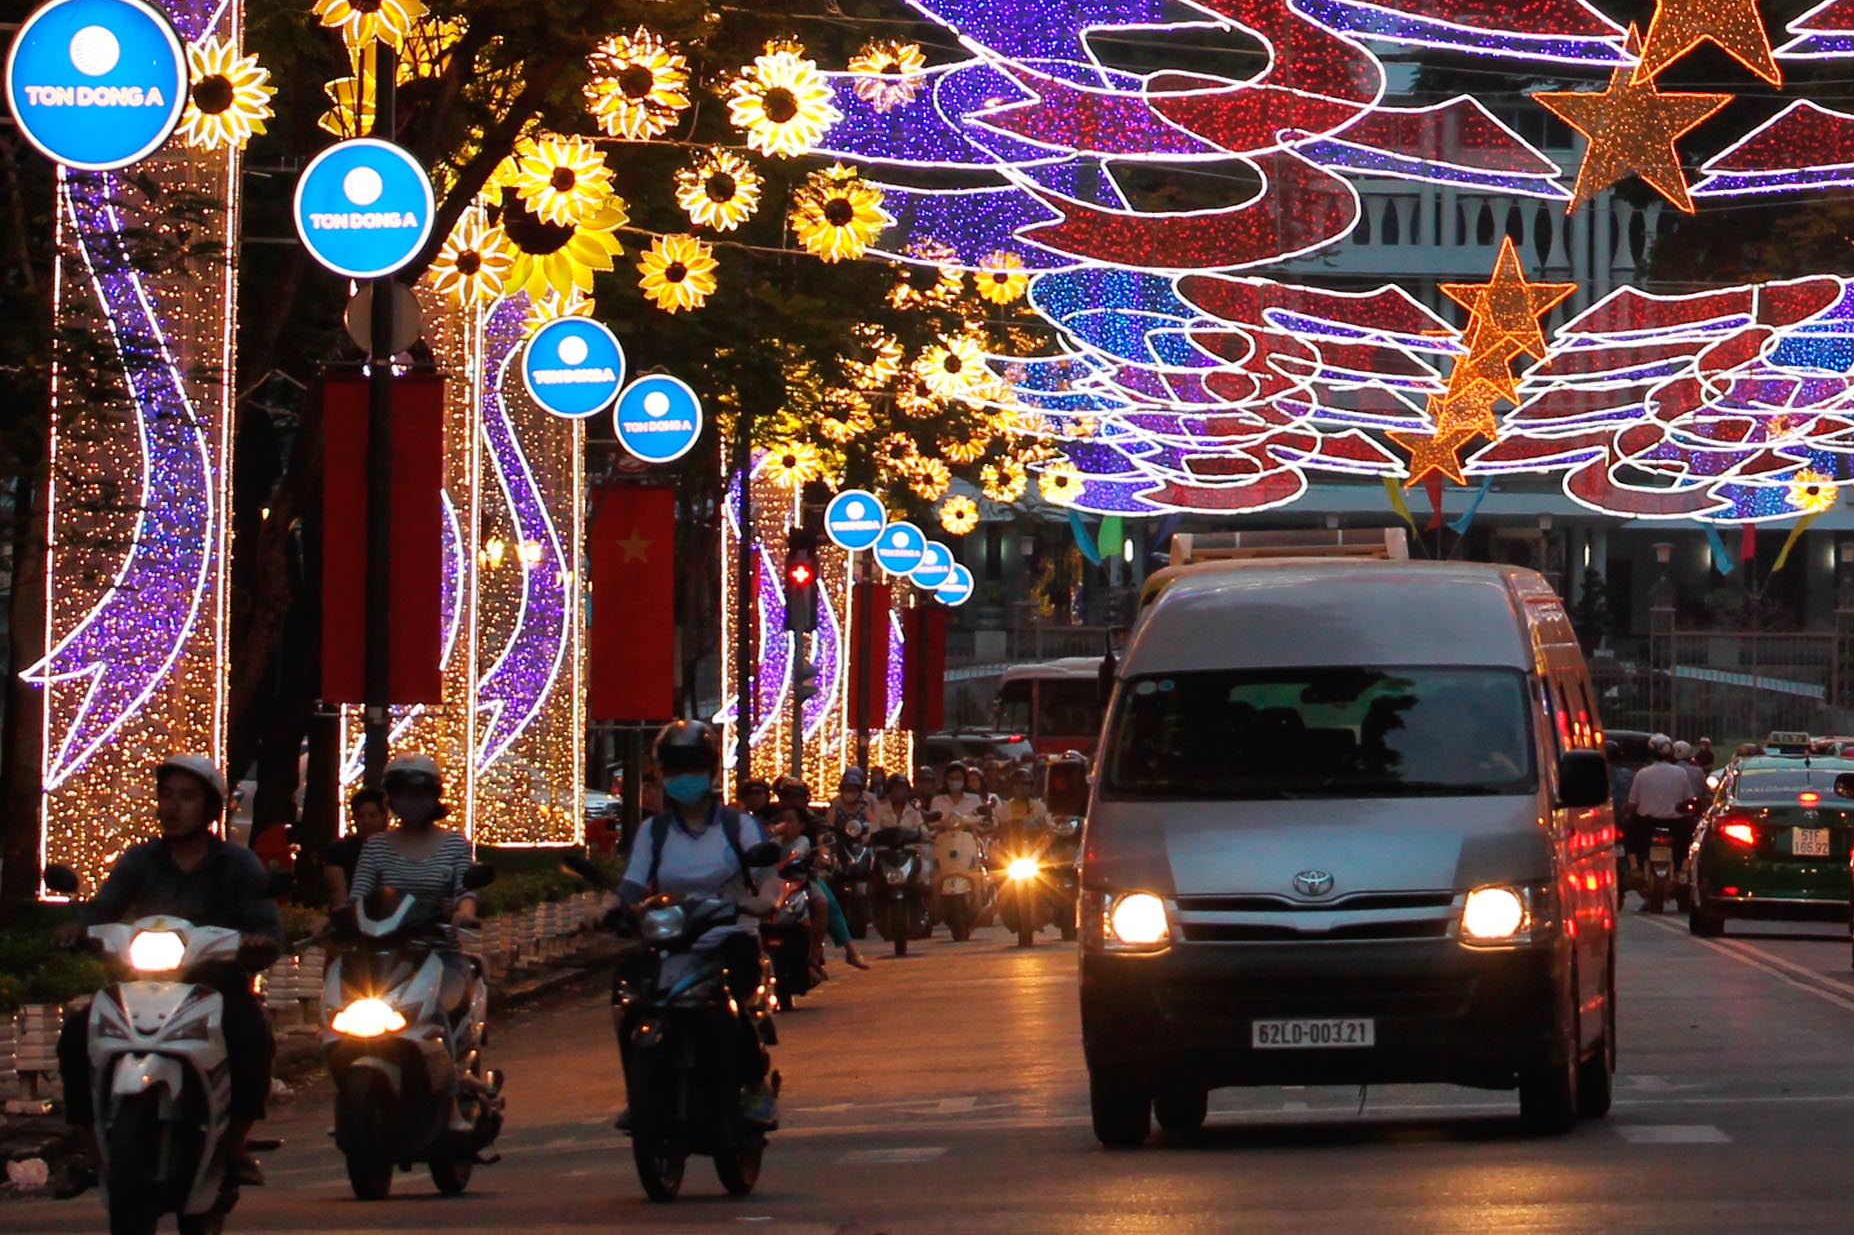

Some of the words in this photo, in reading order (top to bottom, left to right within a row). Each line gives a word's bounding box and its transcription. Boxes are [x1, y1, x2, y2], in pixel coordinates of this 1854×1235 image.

[24, 85, 74, 107] TON
[76, 85, 144, 107] DONG
[144, 86, 165, 107] A
[402, 211, 418, 228] A
